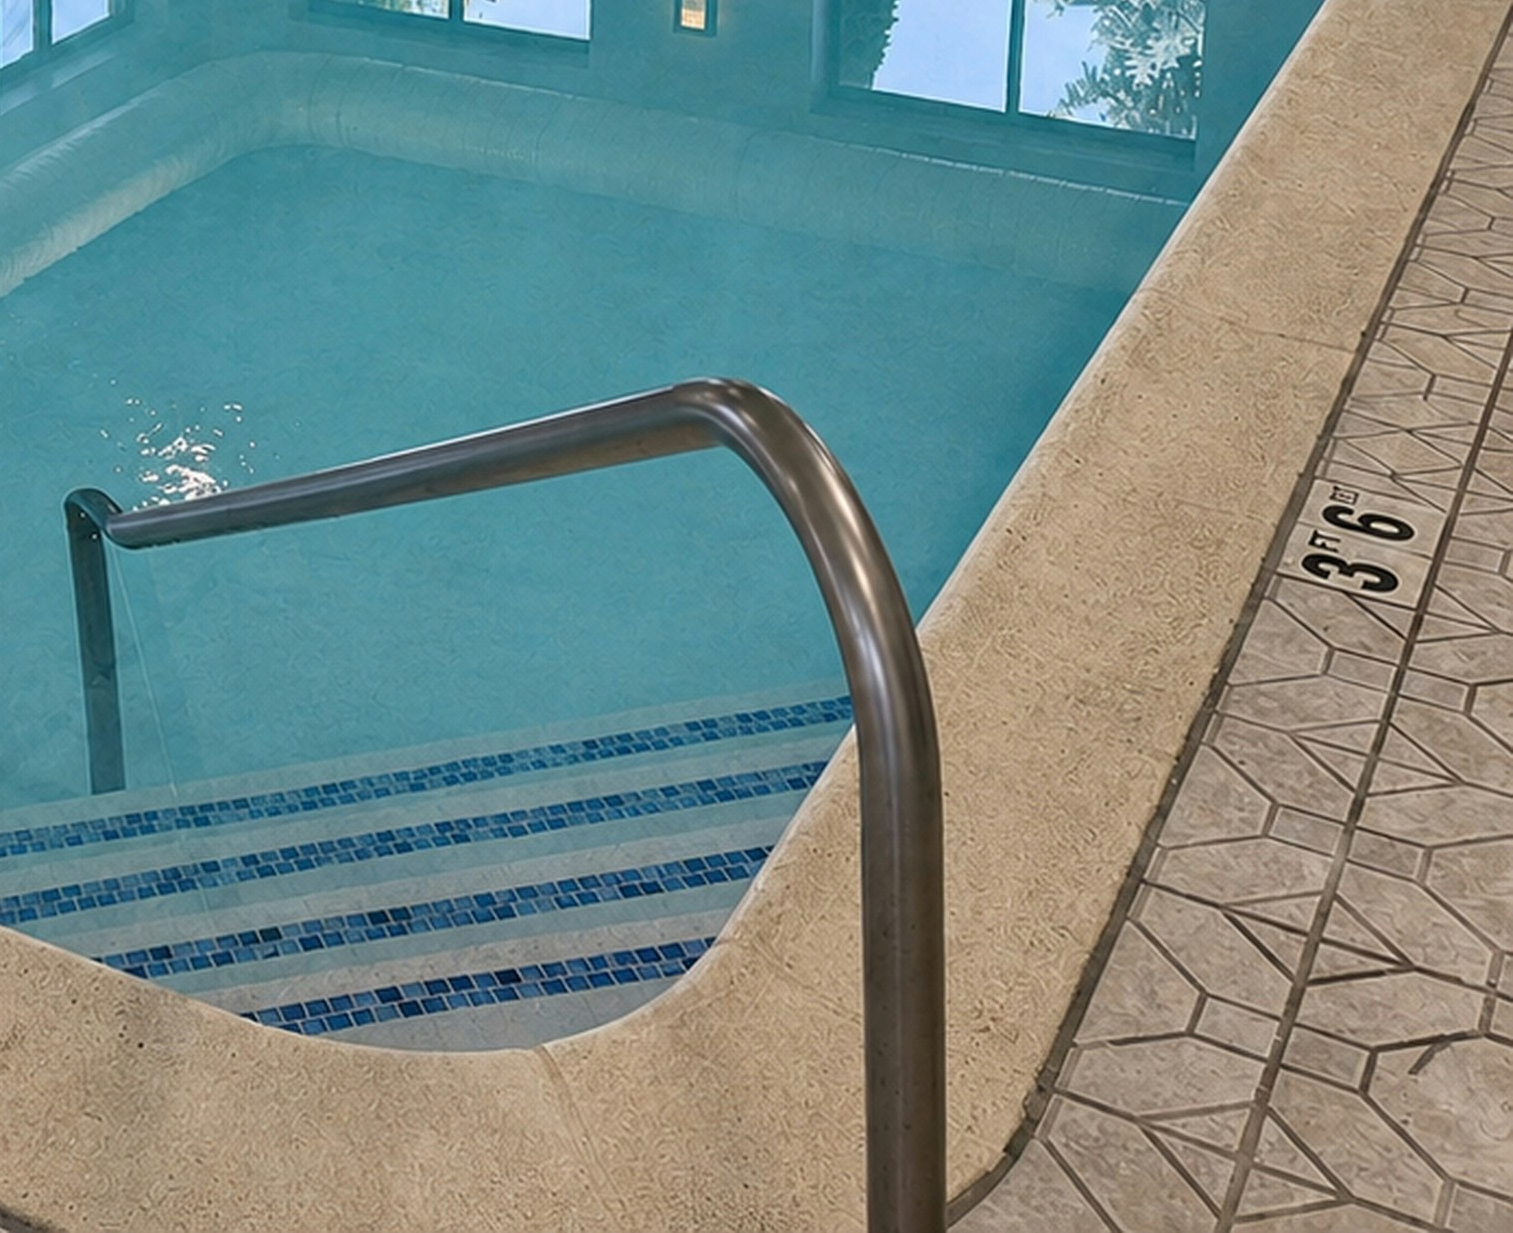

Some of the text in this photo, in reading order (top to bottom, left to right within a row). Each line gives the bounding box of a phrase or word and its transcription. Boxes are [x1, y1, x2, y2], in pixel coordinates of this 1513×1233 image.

[1301, 504, 1415, 593] 3 FT 6
